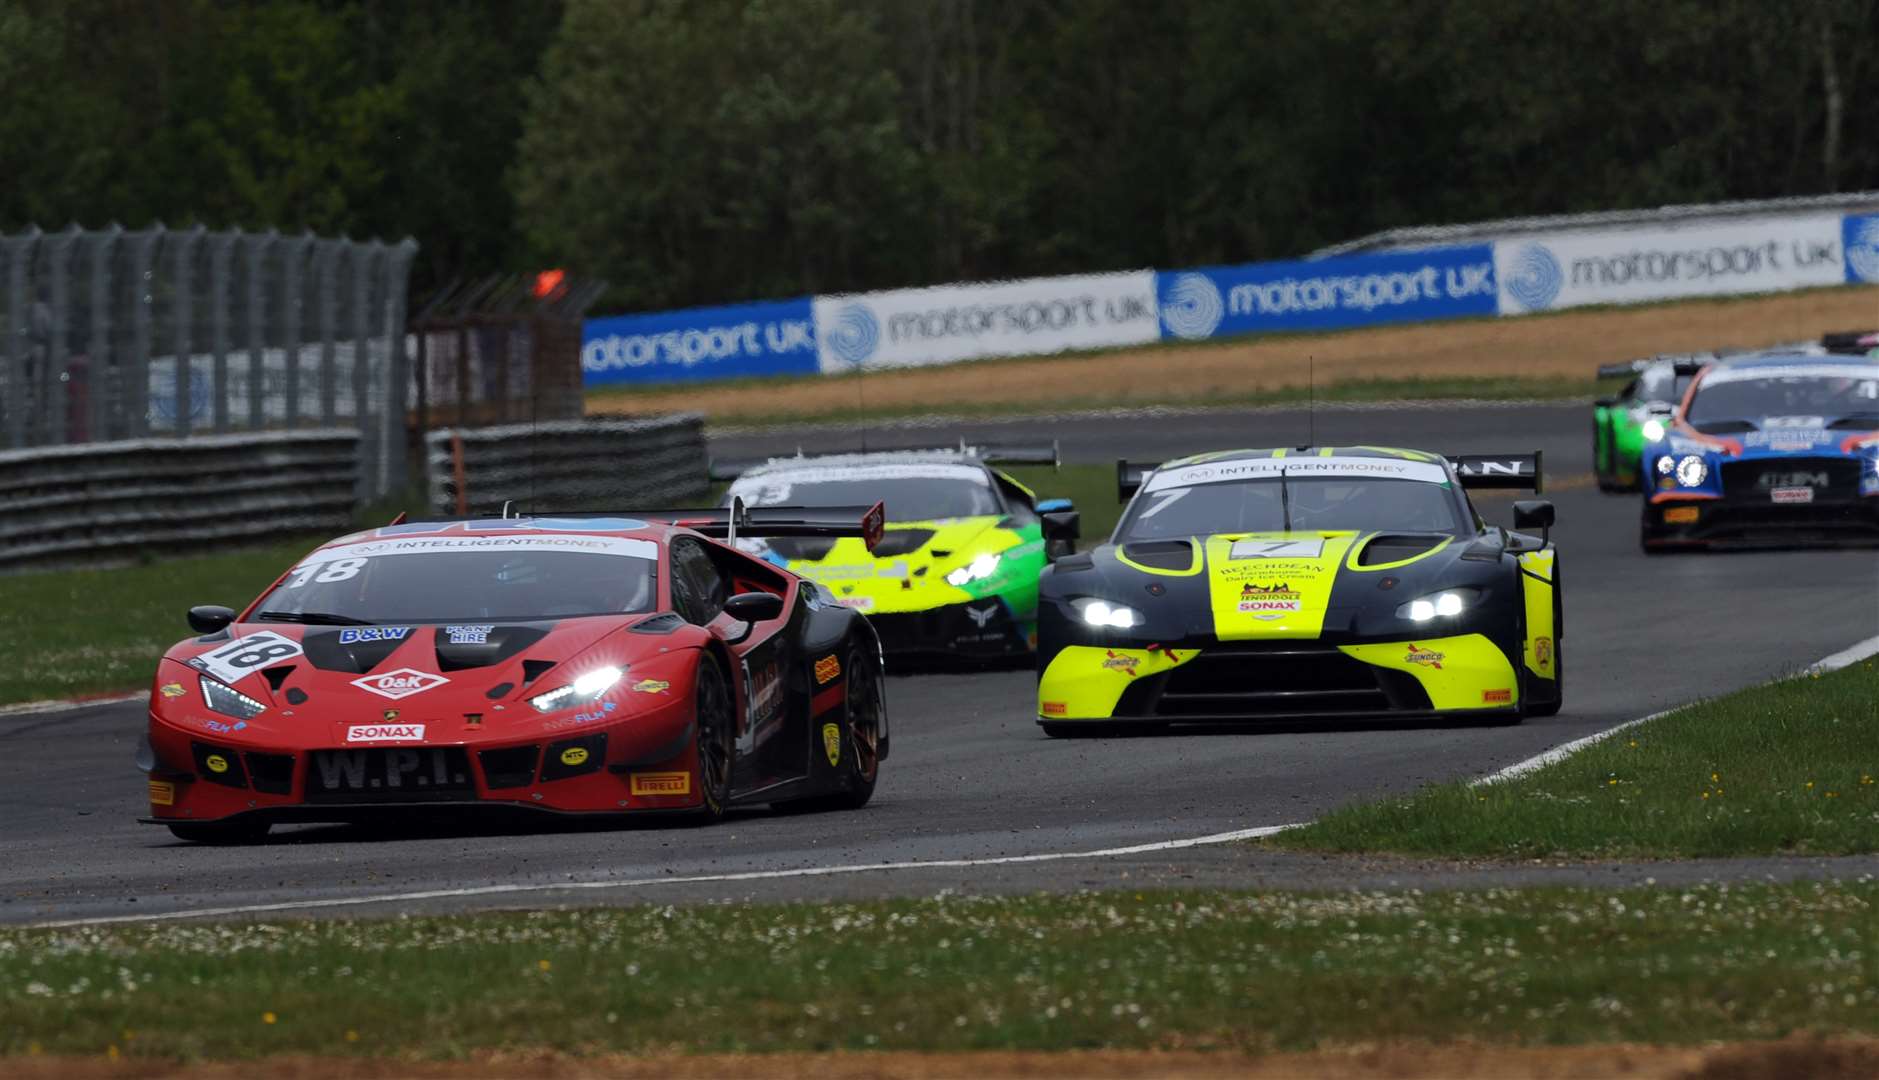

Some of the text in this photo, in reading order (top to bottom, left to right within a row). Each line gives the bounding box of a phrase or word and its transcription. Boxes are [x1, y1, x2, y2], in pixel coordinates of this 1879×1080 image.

[1571, 239, 1780, 288] motorsport
[1230, 264, 1441, 316] motorsport
[888, 296, 1097, 342] motorsport
[581, 320, 760, 372] otorsport
[1139, 488, 1192, 519] 7
[289, 557, 368, 589] 18
[1240, 601, 1296, 611] SONAX
[339, 626, 410, 644] B&W
[212, 636, 298, 668] 18
[351, 726, 417, 739] SONAX
[637, 776, 686, 791] PIRELLI
